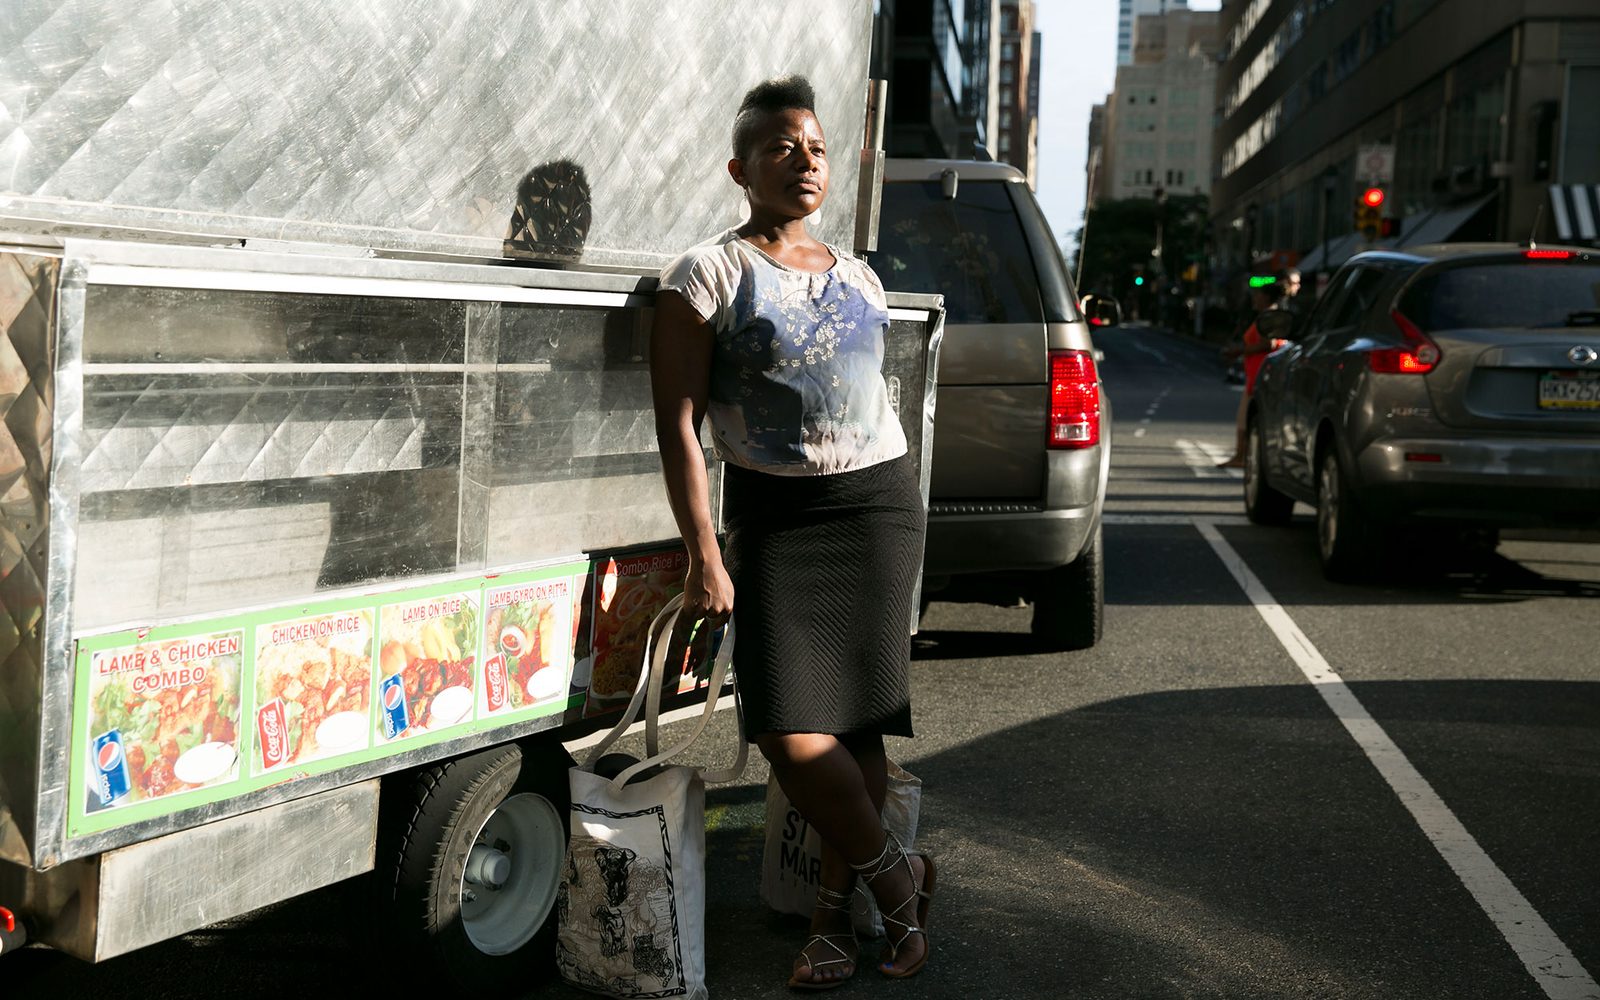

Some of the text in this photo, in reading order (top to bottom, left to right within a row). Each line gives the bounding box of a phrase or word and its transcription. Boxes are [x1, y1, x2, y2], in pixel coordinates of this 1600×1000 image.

[614, 552, 691, 577] Combo Rice Pla
[489, 581, 568, 606] LAMB GYRO ON PITTA
[402, 599, 461, 622] LAMB ON RICE
[272, 616, 360, 644] CHICKEN ON RICE
[99, 637, 239, 674] LAMB & CHICKEN
[132, 666, 206, 692] COMBO
[779, 841, 822, 886] MAR
